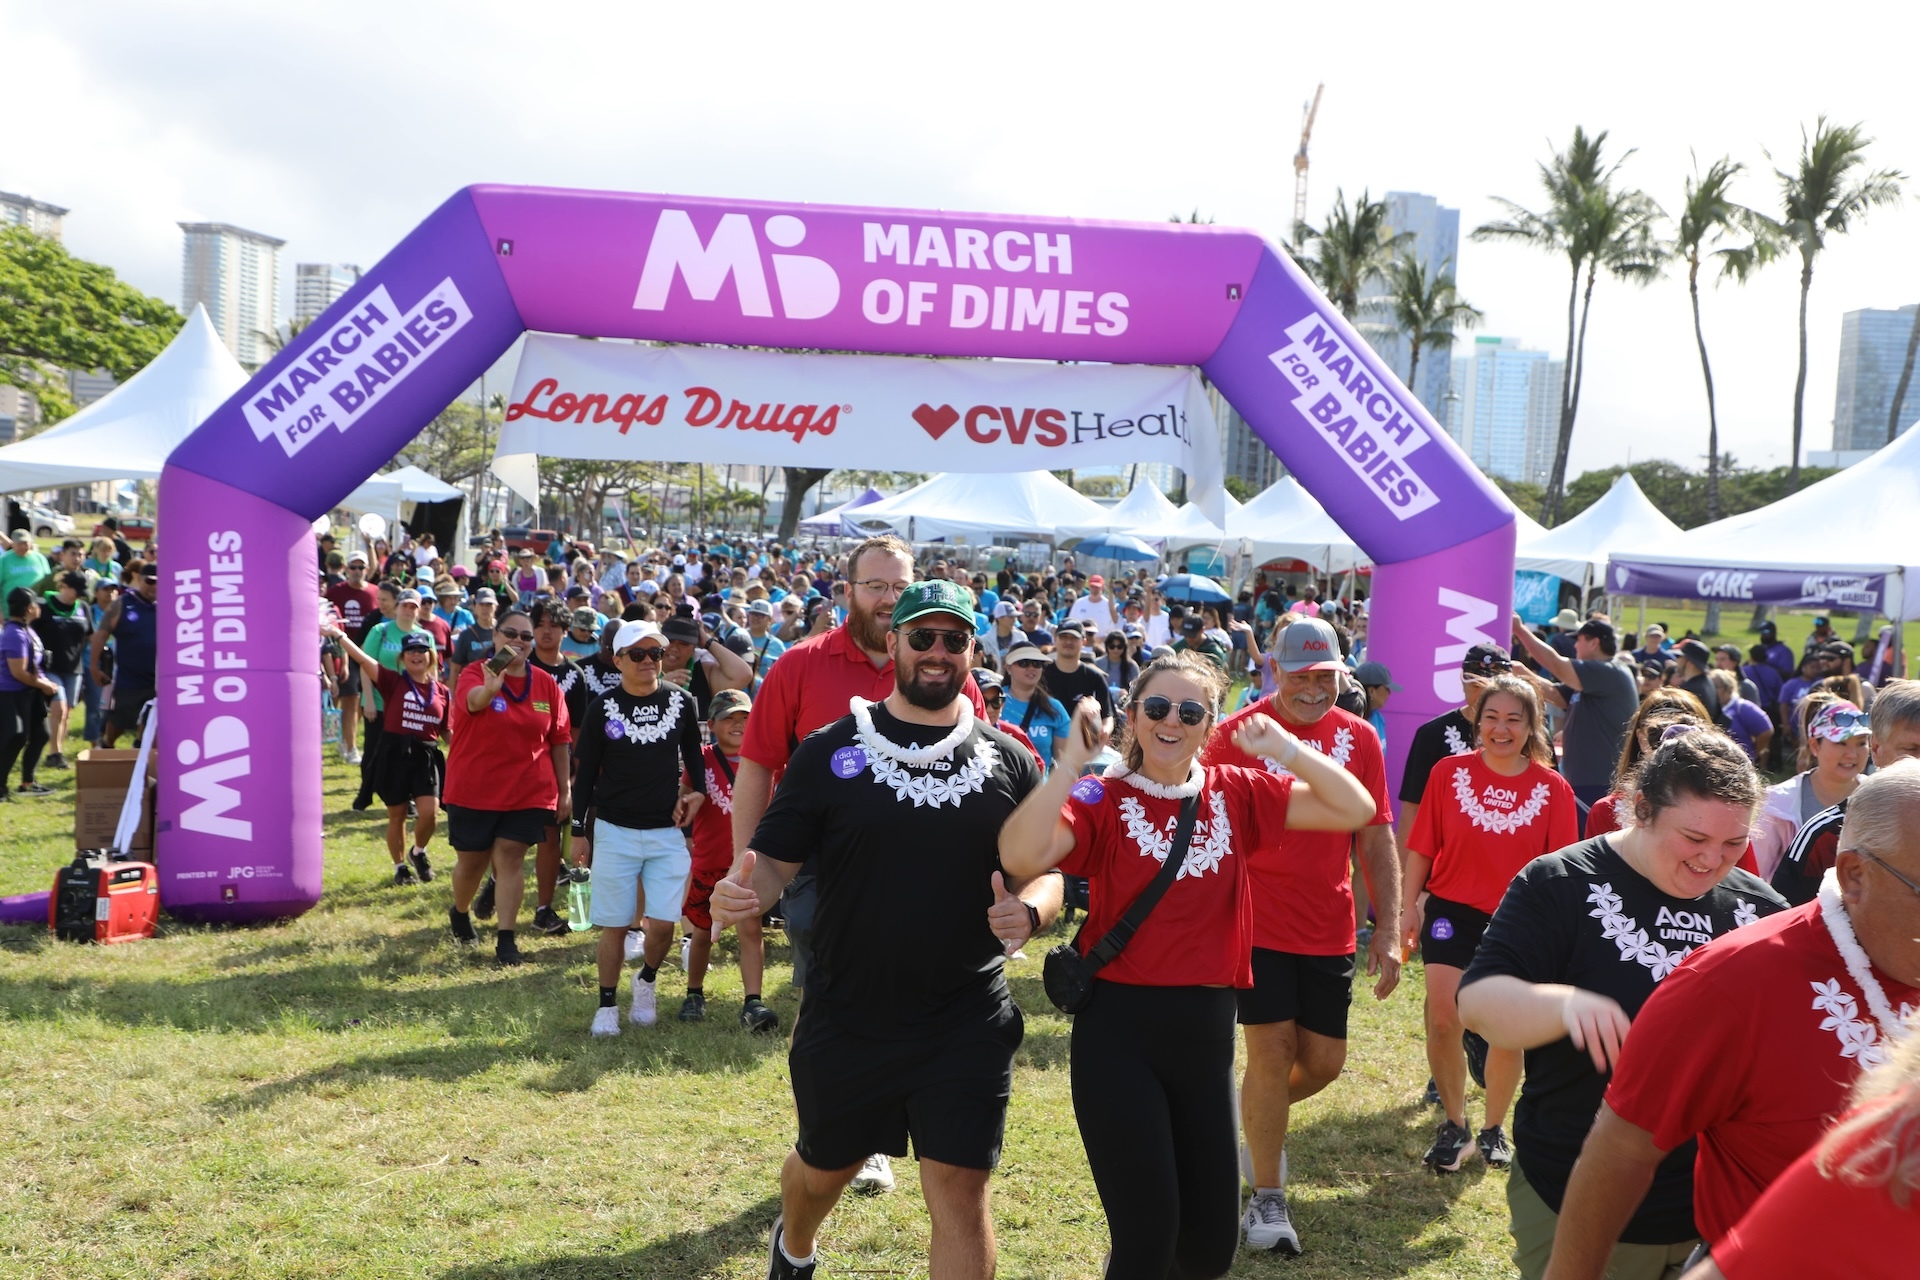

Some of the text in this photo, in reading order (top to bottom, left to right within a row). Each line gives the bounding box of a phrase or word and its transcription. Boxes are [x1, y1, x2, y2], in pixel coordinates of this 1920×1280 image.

[862, 222, 1073, 275] MARCH
[862, 278, 1129, 337] OF DIMES
[254, 302, 389, 422] MARCH
[1303, 323, 1414, 447] MARCH
[505, 378, 669, 435] Longs
[285, 404, 327, 444] FOR
[1282, 353, 1418, 507] FOR BABIES
[1696, 570, 1759, 599] CARE
[208, 530, 248, 702] OF DIMES
[175, 569, 204, 705] MARCH
[1302, 639, 1329, 652] AON
[602, 672, 622, 680] AON
[632, 705, 659, 717] AON
[402, 720, 424, 731] BANK
[839, 751, 851, 759] did
[907, 761, 951, 771] UNITED
[1482, 785, 1517, 803] AON
[1483, 797, 1513, 809] UNITED
[1165, 815, 1208, 834] AN
[176, 872, 206, 880] PRINTED
[227, 866, 255, 879] JPG
[1655, 906, 1714, 933] AON
[1660, 928, 1712, 945] UNITED
